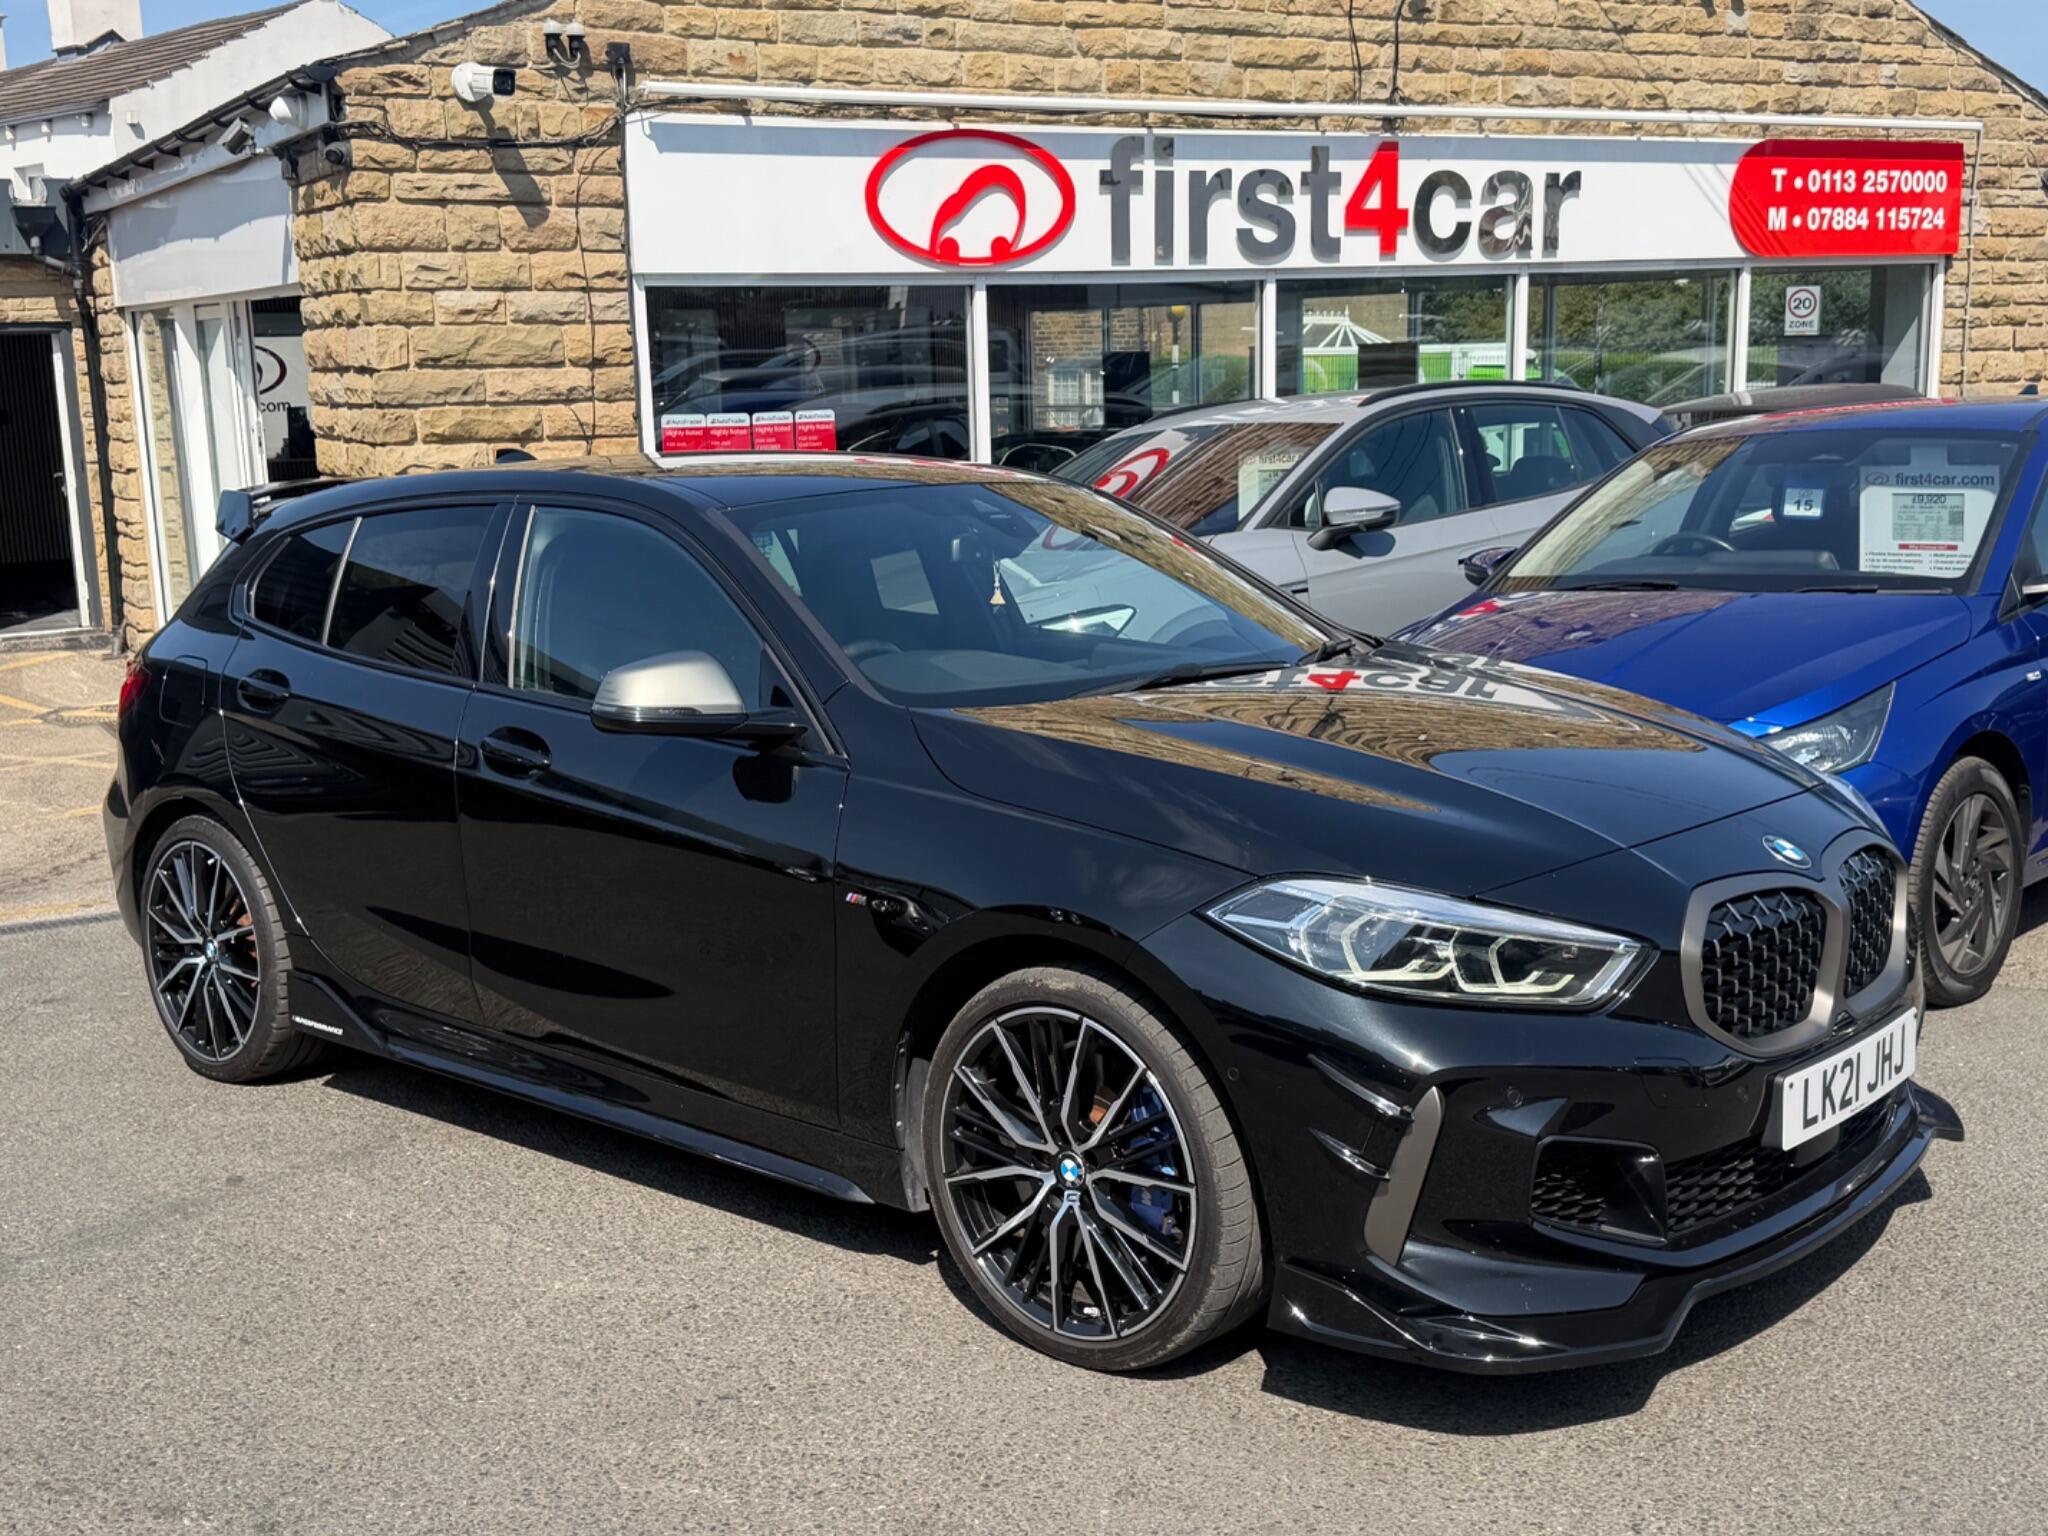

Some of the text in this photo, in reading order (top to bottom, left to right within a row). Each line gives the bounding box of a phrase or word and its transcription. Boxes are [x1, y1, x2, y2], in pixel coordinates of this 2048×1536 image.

[1771, 168, 1948, 193] T 0113 2570000
[1099, 136, 1582, 265] first4car
[1768, 207, 1945, 231] M 07884 115724
[1793, 297, 1812, 310] 20
[1788, 320, 1816, 329] ZONE
[1895, 472, 1995, 486] first4car.com
[1793, 499, 1814, 511] 15
[1802, 1024, 1906, 1130] LK21 JHJ
